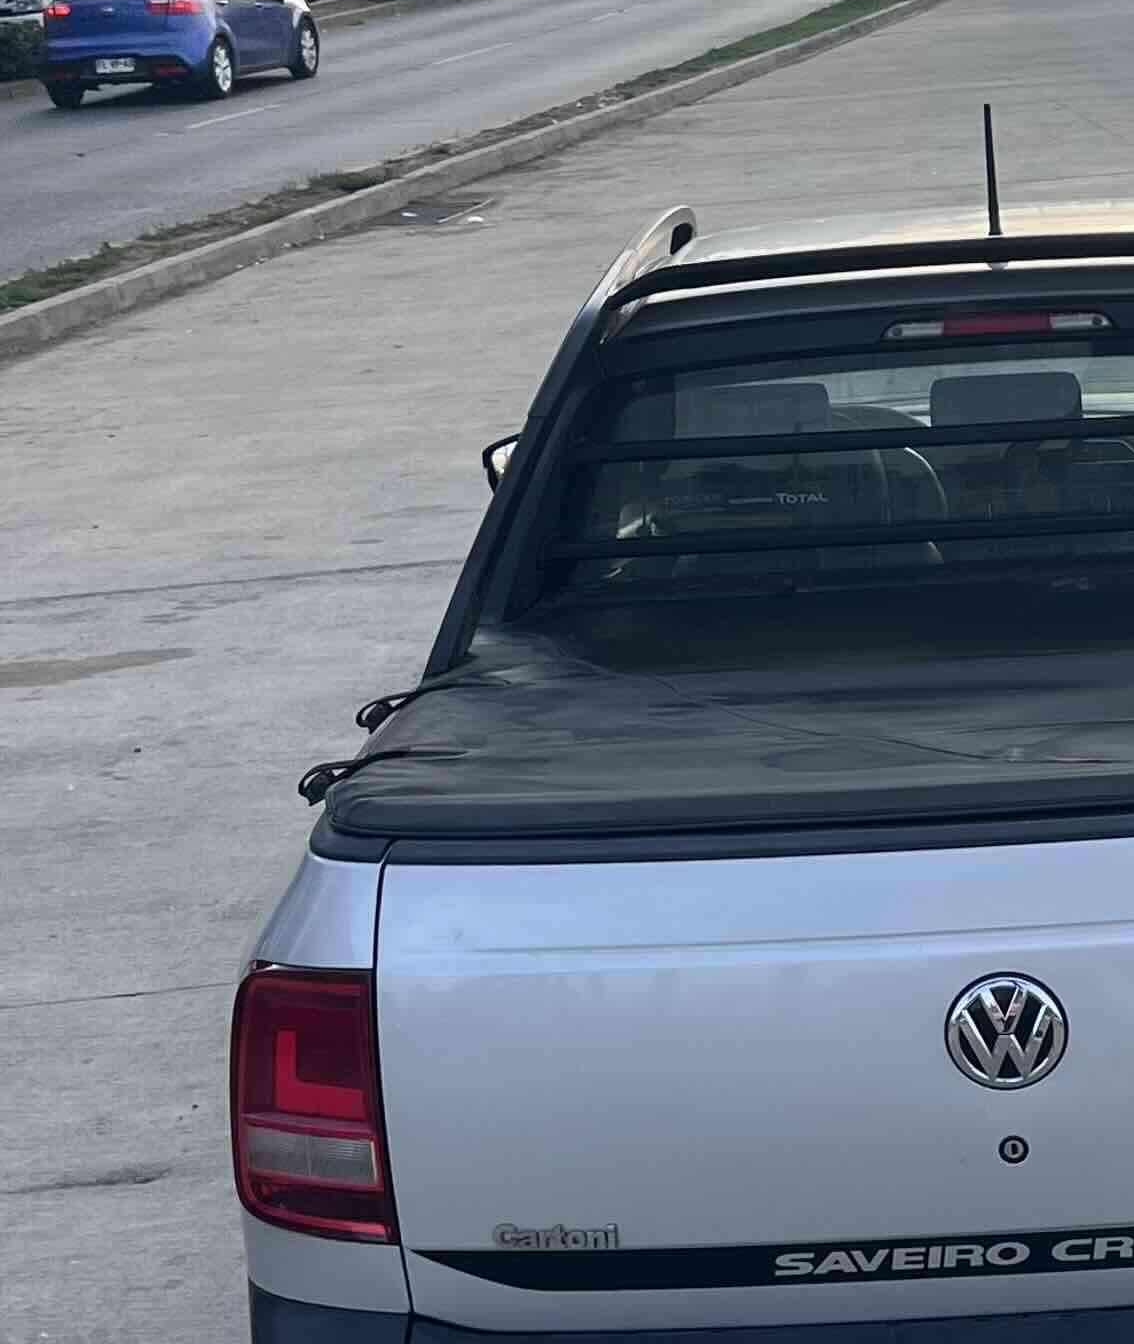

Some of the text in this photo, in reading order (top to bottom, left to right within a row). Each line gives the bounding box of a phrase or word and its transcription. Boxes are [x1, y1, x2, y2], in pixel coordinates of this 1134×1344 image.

[775, 492, 830, 505] TOTAL
[492, 1222, 619, 1250] Cartoni
[775, 1241, 1031, 1277] SAVEIRO
